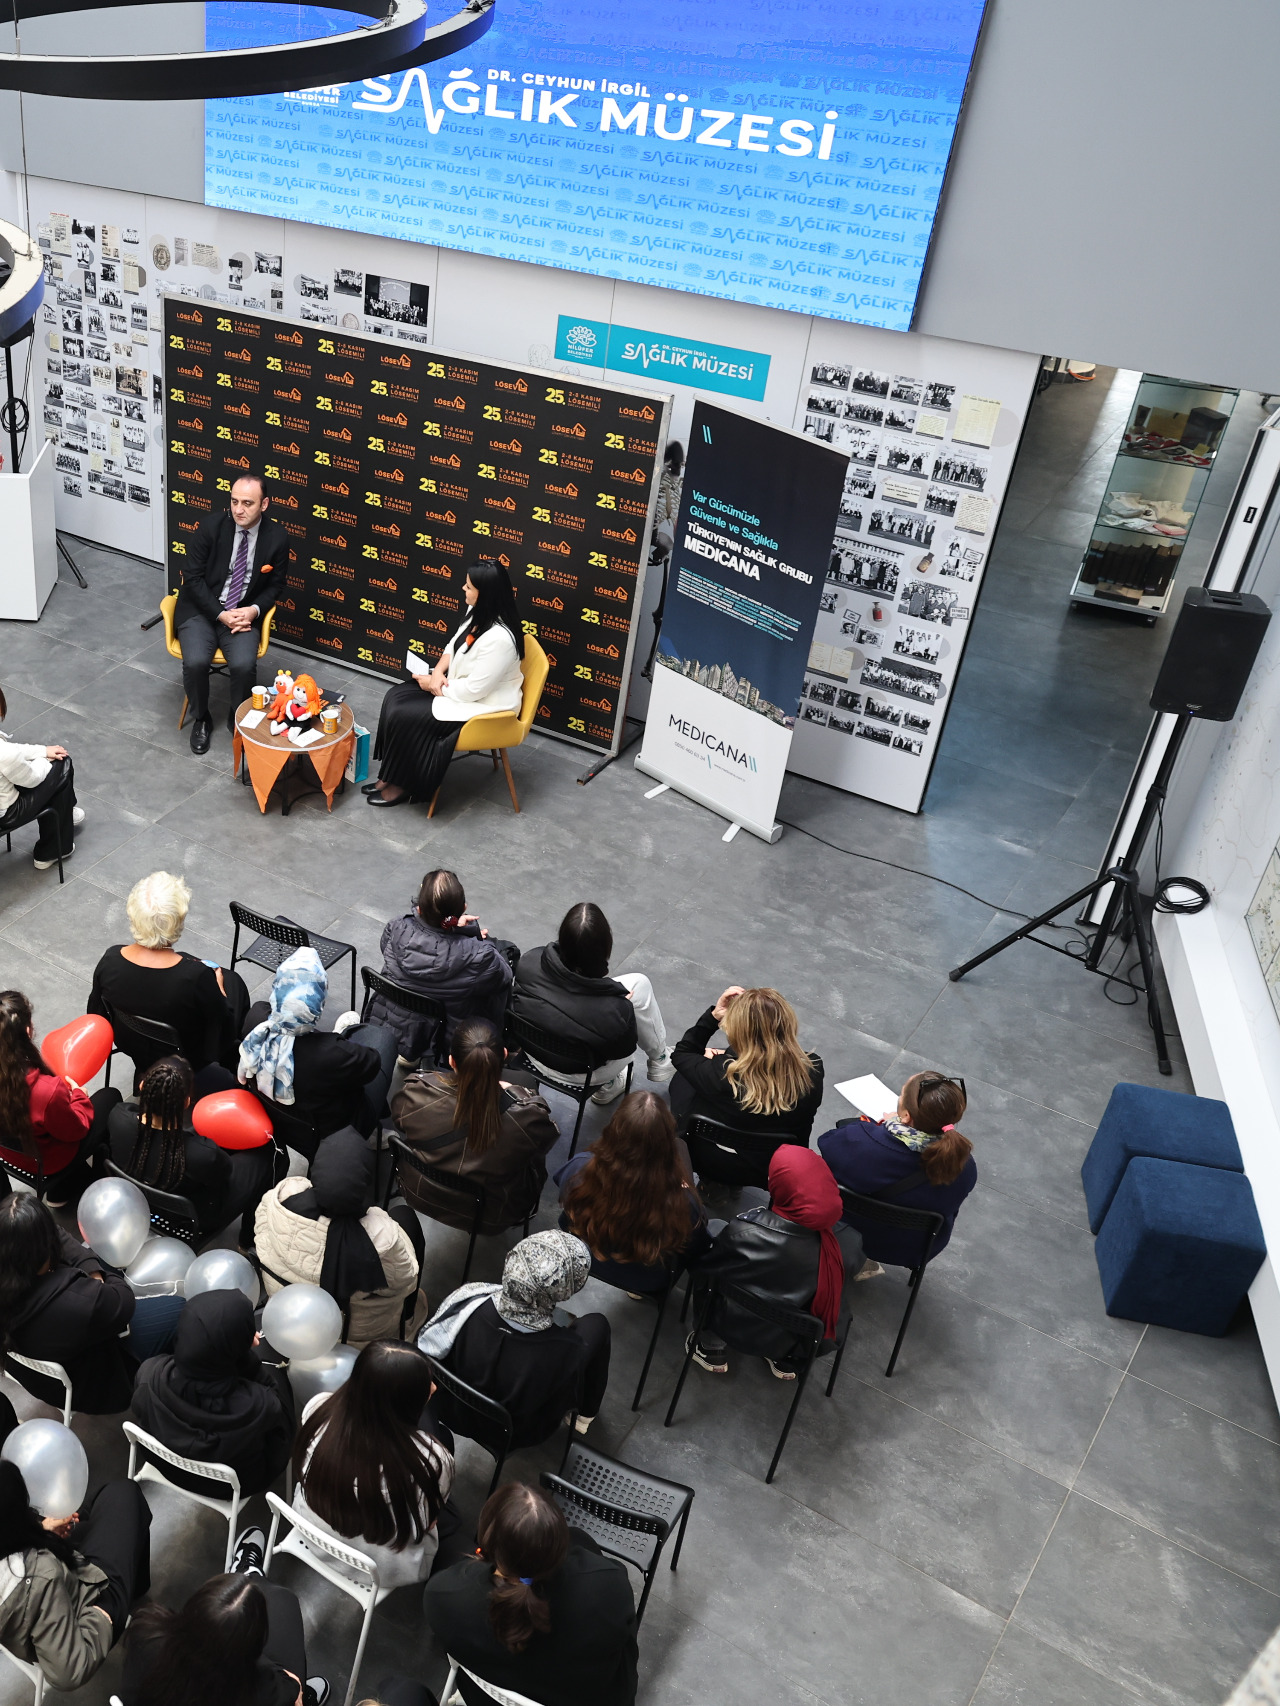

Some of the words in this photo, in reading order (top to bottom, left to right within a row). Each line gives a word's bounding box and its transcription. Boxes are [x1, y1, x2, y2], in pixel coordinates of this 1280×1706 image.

[488, 68, 515, 82] DR.
[522, 72, 596, 92] CEYHUN
[601, 78, 651, 98] İRGİL
[352, 67, 577, 134] SAĞLIK
[599, 92, 838, 160] MÜZESİ
[177, 310, 198, 321] LÖSEV
[217, 318, 233, 333] 25.
[169, 335, 185, 350] 25.
[275, 332, 298, 342] LÖSEV
[224, 349, 246, 360] LÖSEV
[381, 355, 405, 366] LÖSEV
[621, 343, 687, 368] SAĞLIK
[692, 356, 754, 380] MÜZESİ
[266, 357, 283, 372] 25.
[427, 362, 446, 379] 25.
[370, 380, 388, 396] 25.
[495, 379, 522, 391] LÖSEV
[274, 388, 296, 399] LÖSEV
[545, 388, 566, 405] 25.
[434, 397, 460, 408] LÖSEV
[378, 413, 402, 424] LÖSEV
[483, 405, 502, 422] 25.
[619, 406, 648, 418] LÖSEV
[423, 421, 442, 438] 25.
[539, 449, 558, 466] 25.
[611, 469, 639, 480] LÖSEV
[312, 504, 329, 520] 25.
[692, 490, 707, 504] Var
[708, 498, 760, 526] Gücümüzle
[426, 511, 450, 522] LÖSEV
[690, 506, 726, 528] Güvenle
[729, 523, 740, 534] ve
[742, 528, 779, 551] Sağlıkla
[415, 533, 433, 549] 25.
[684, 535, 761, 581] MEDICANA
[687, 522, 742, 553] TÜRKİYE'NİN
[743, 547, 778, 569] SAĞLIK
[778, 563, 813, 585] GRUBU
[526, 564, 545, 580] 25.
[369, 578, 392, 588] LÖSEV
[360, 598, 376, 613] 25.
[532, 598, 558, 608] LÖSEV
[587, 645, 613, 656] LÖSEV
[669, 714, 748, 768] MEDICANA
